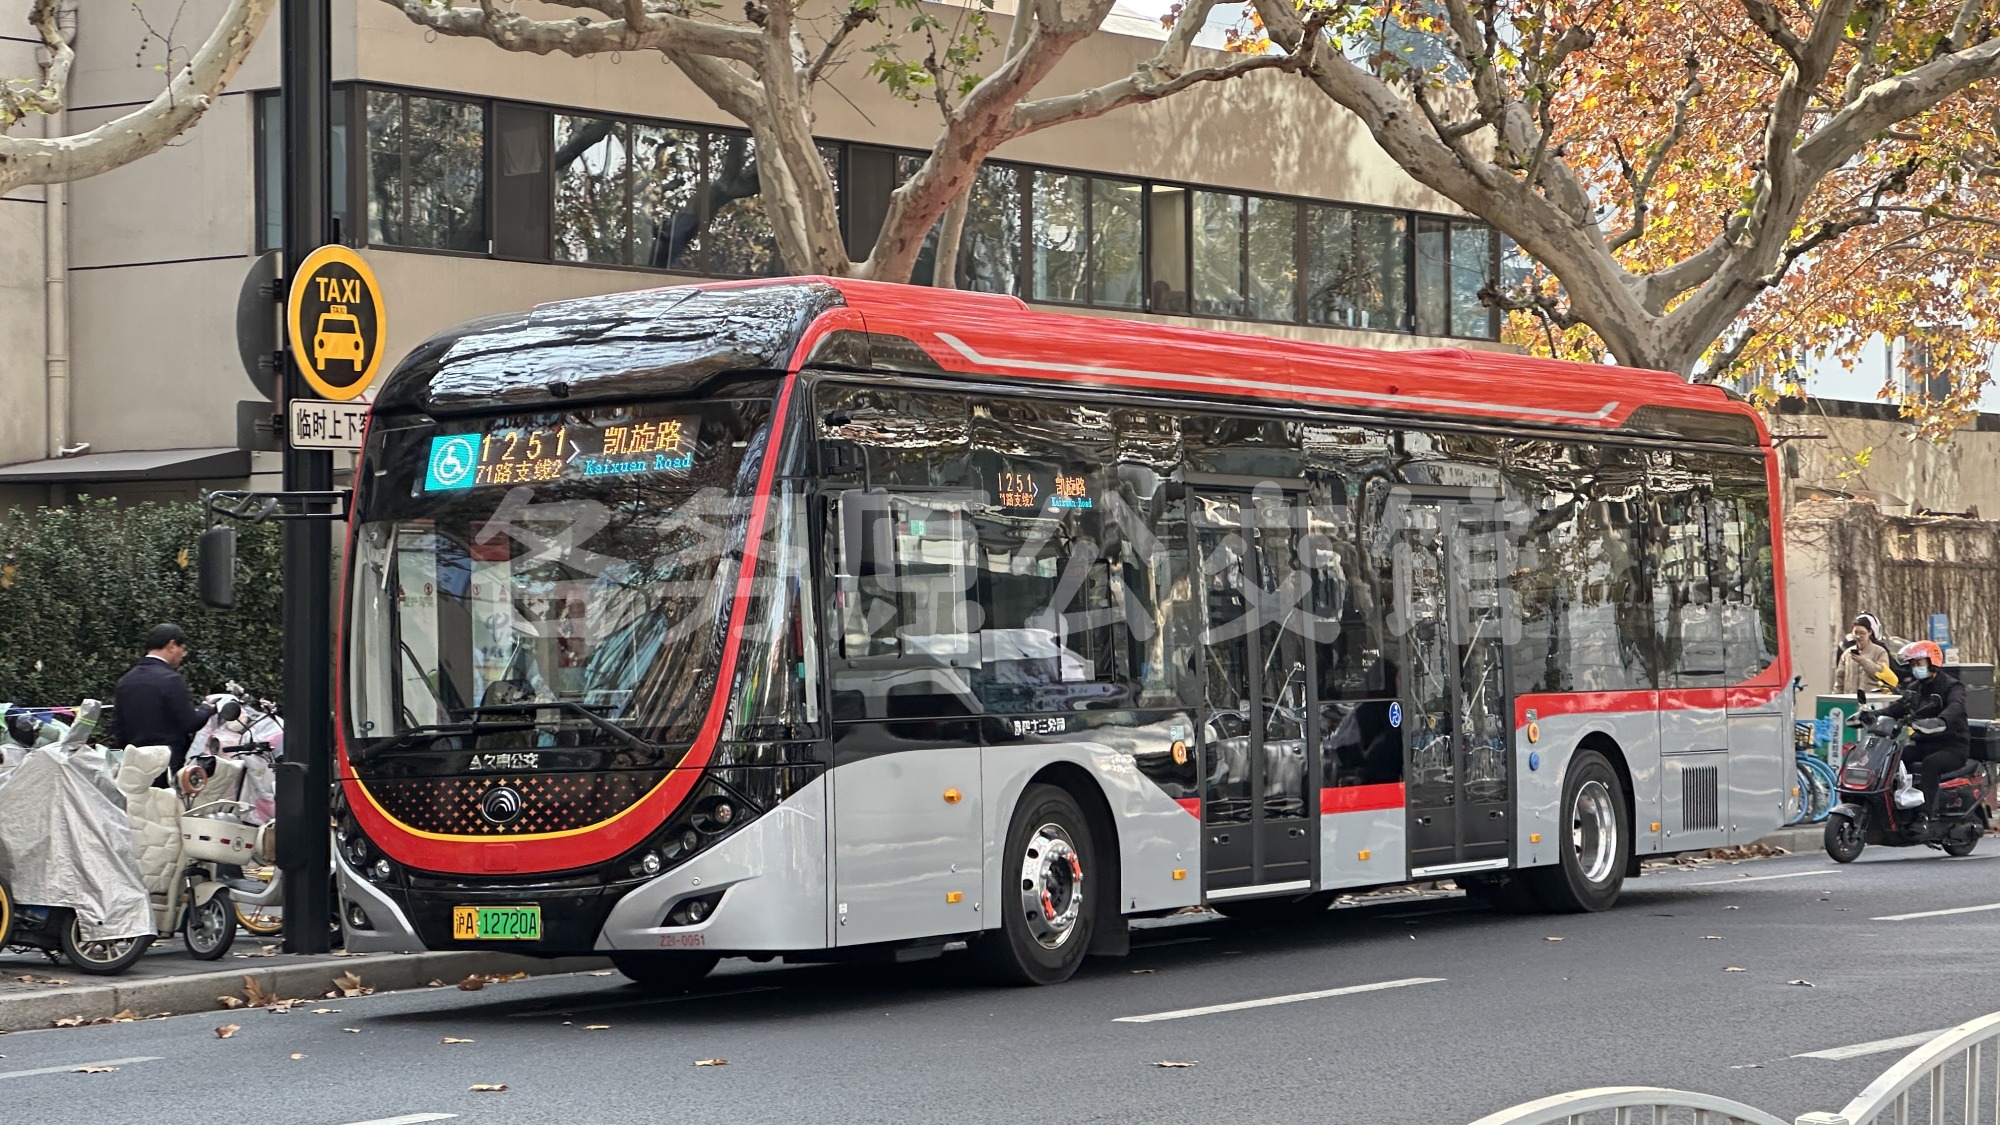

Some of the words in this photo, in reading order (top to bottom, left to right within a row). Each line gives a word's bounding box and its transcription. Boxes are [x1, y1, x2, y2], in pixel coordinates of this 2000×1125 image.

[316, 277, 361, 304] TAXI
[482, 426, 566, 462] 1251
[602, 419, 682, 456] 凯旋路
[475, 458, 562, 484] 71路支线2
[583, 459, 646, 477] Kaixuan
[655, 452, 692, 471] Road
[998, 472, 1033, 492] 1251
[1055, 476, 1086, 497] 凯旋路
[456, 912, 475, 934] 沪A
[483, 912, 537, 934] 12720A
